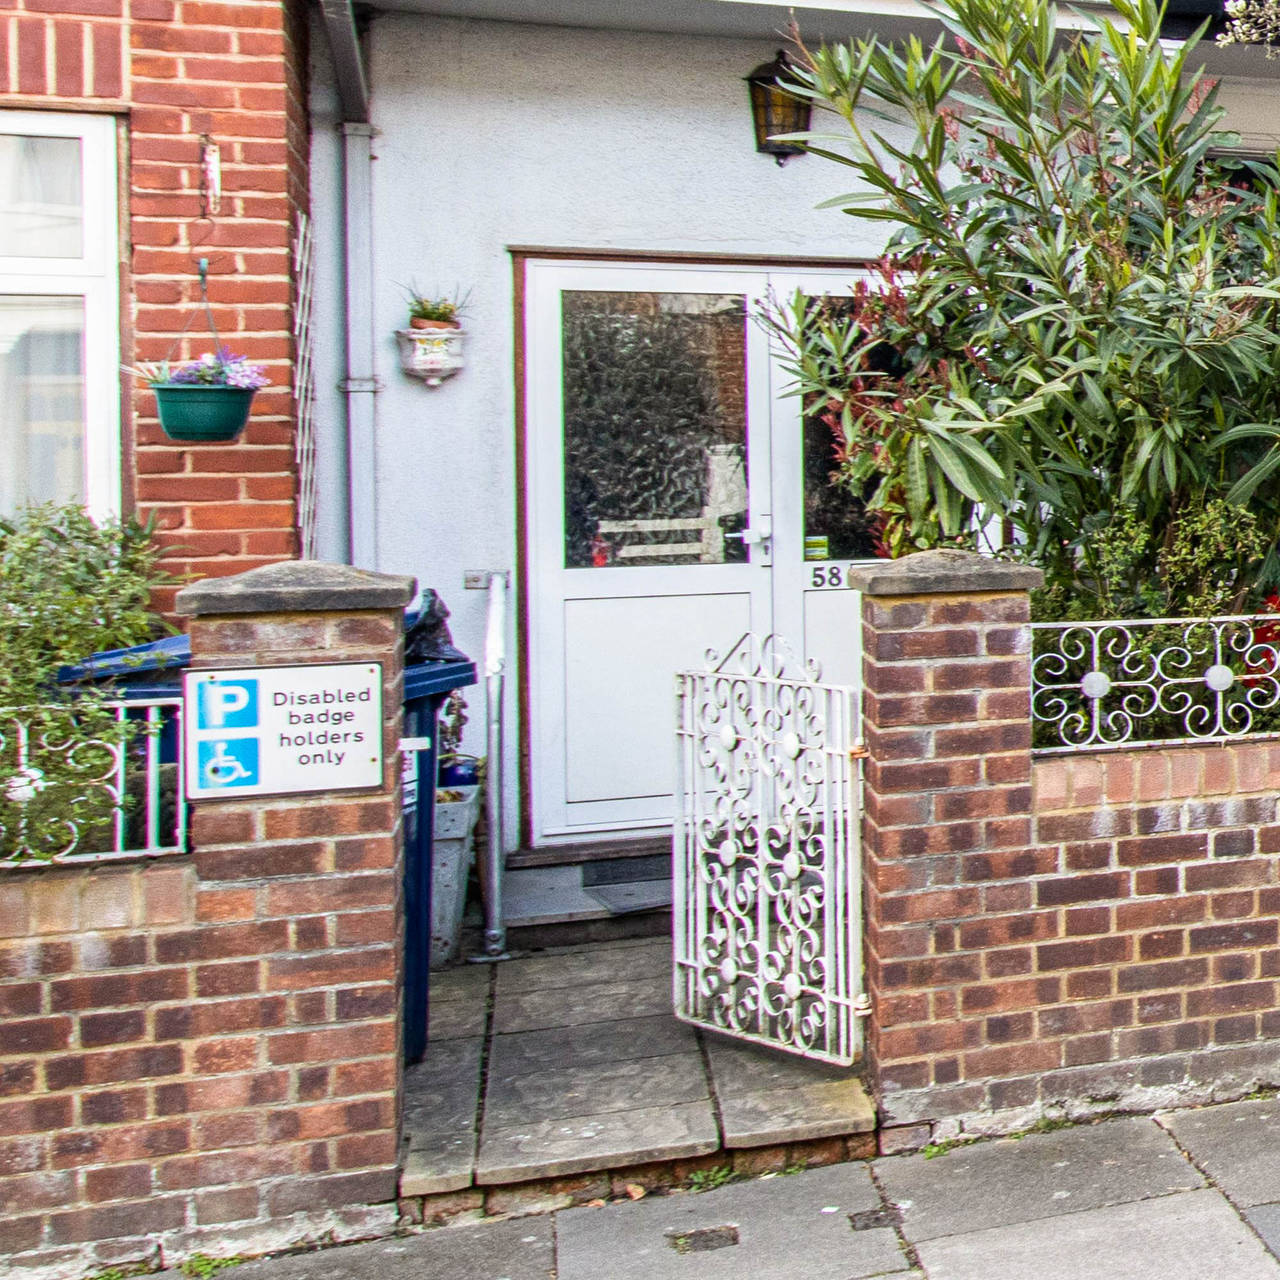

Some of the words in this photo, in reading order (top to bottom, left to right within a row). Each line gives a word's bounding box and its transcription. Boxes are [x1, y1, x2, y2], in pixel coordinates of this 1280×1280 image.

[812, 566, 842, 587] 58
[207, 685, 250, 727] P
[272, 688, 371, 707] Disabled
[289, 709, 355, 726] badge
[280, 730, 364, 747] holders
[298, 749, 346, 766] only
